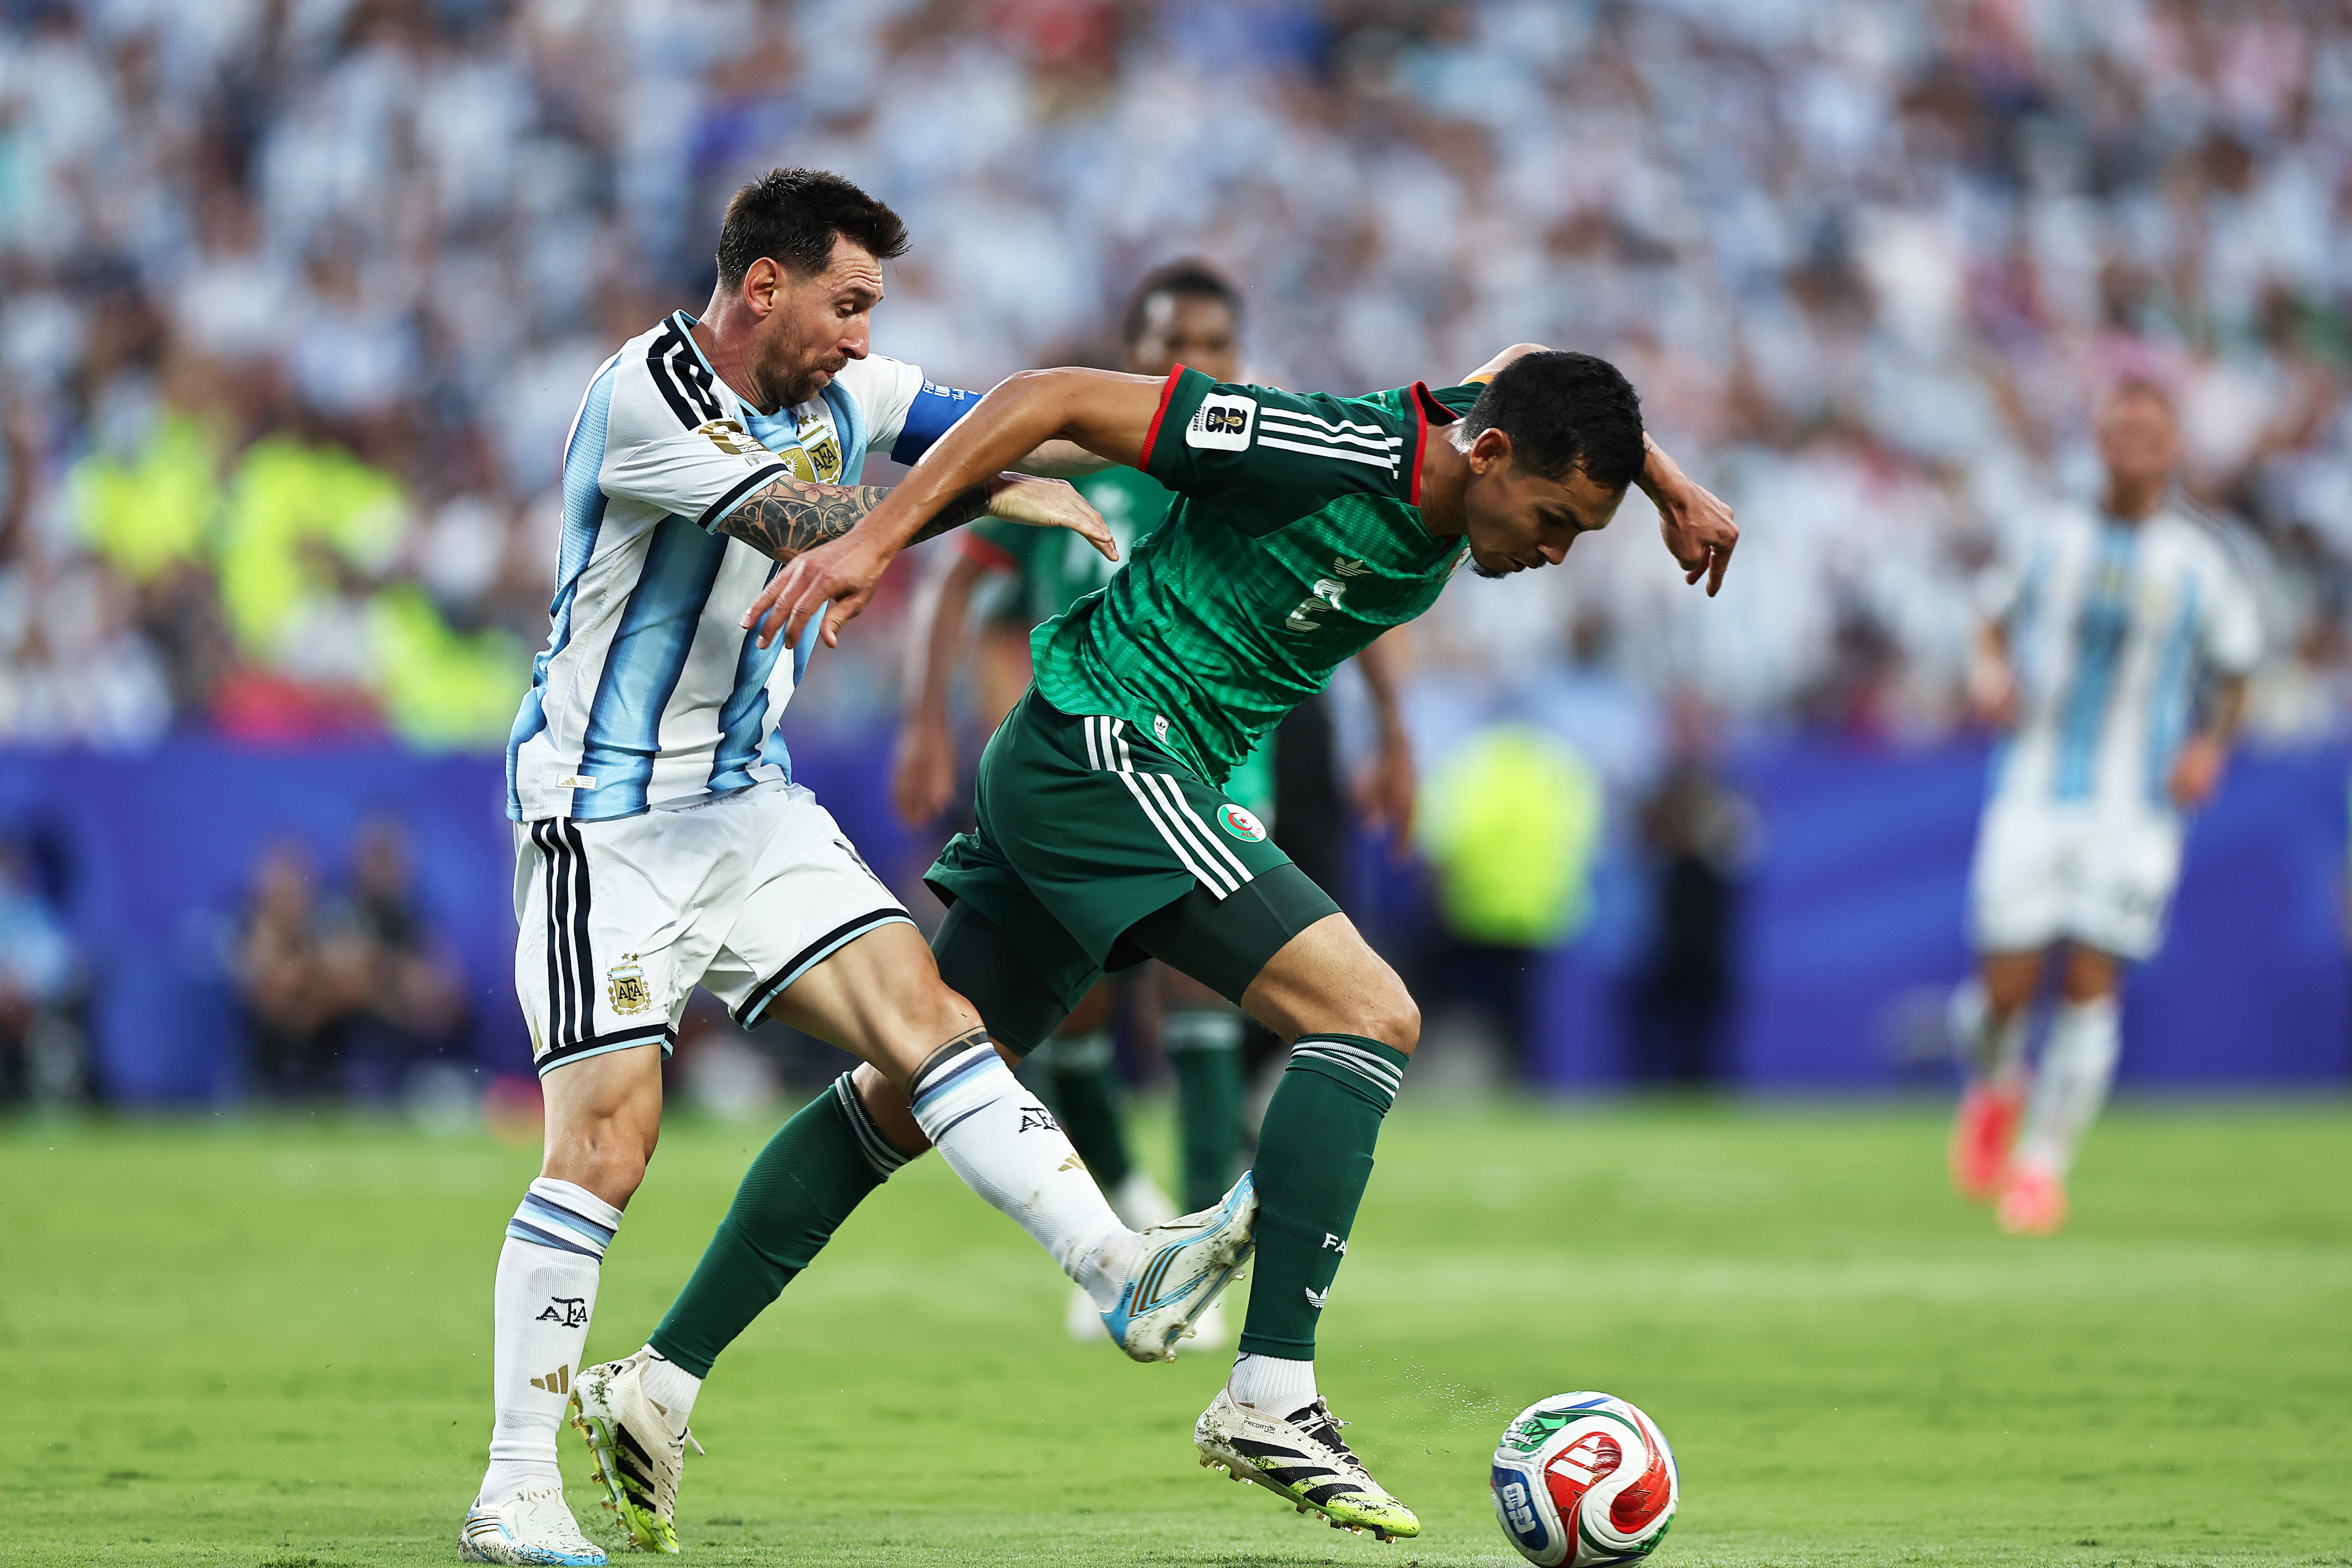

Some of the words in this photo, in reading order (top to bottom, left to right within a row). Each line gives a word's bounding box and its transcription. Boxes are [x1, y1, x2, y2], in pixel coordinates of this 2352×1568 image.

[1208, 413, 1216, 425] FIFA
[739, 444, 764, 453] 2026
[810, 442, 837, 471] AFA
[1241, 828, 1262, 838] ALGERIA
[618, 978, 643, 1001] AFA
[535, 1297, 588, 1328] AFA
[1243, 1419, 1276, 1432] PREDATOR
